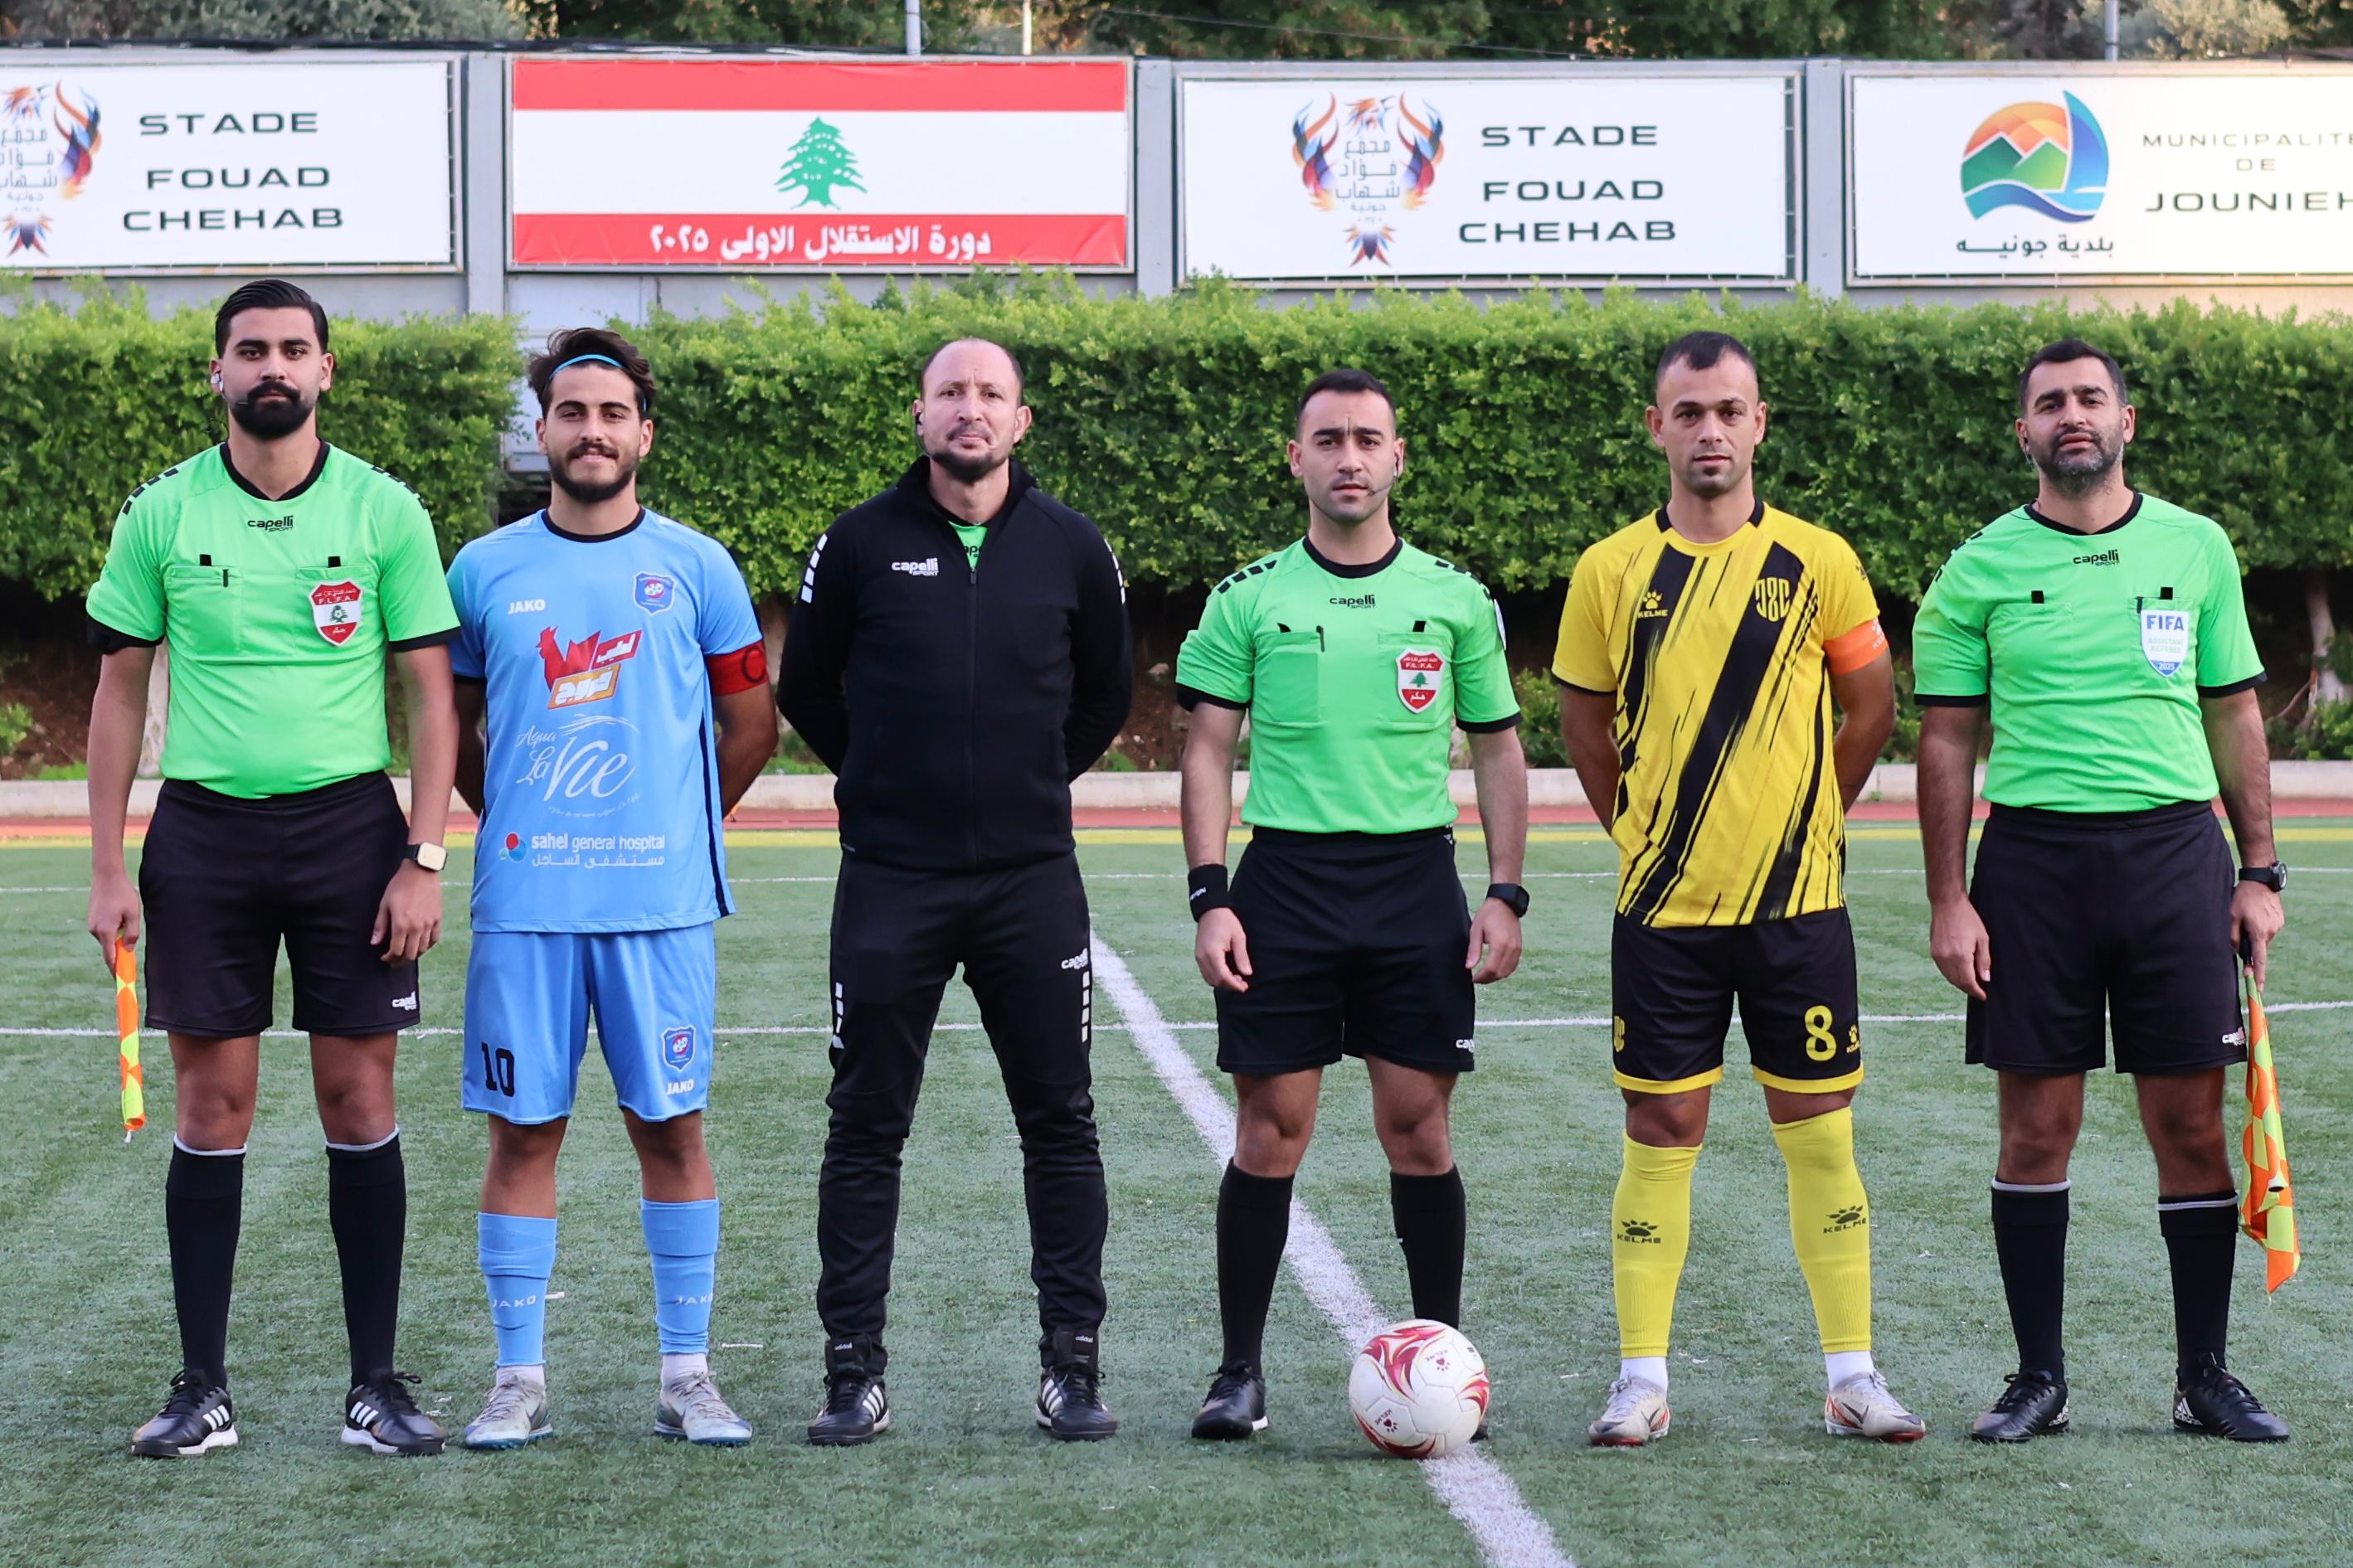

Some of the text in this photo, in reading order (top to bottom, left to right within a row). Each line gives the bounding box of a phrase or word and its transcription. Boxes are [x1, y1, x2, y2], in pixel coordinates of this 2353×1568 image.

[139, 113, 318, 135] STADE
[1481, 125, 1657, 147] STADE
[2235, 158, 2277, 172] DE
[147, 167, 330, 190] FOUAD
[1483, 180, 1664, 201] FOUAD
[123, 208, 343, 231] CHEHAB
[649, 224, 709, 253] ٢٠٢٥
[804, 225, 919, 260] الاستقلال
[929, 224, 991, 260] دورة
[1459, 221, 1676, 243] CHEHAB
[2057, 235, 2114, 259] بلدية
[247, 514, 294, 531] capelli
[891, 557, 938, 574] capelli
[2073, 549, 2119, 566] capelli
[508, 599, 546, 615] JAKO
[1329, 594, 1375, 607] capelli
[1637, 609, 1669, 619] KELME
[2146, 614, 2185, 631] FIFA
[542, 736, 637, 802] Vie
[531, 828, 666, 853] sahel general hospital
[1804, 1005, 1837, 1061] 8
[481, 1041, 515, 1098] 10
[666, 1078, 694, 1095] JAKO
[1823, 1217, 1866, 1235] KELME
[1616, 1233, 1661, 1244] KELME
[493, 1294, 537, 1308] JAKO
